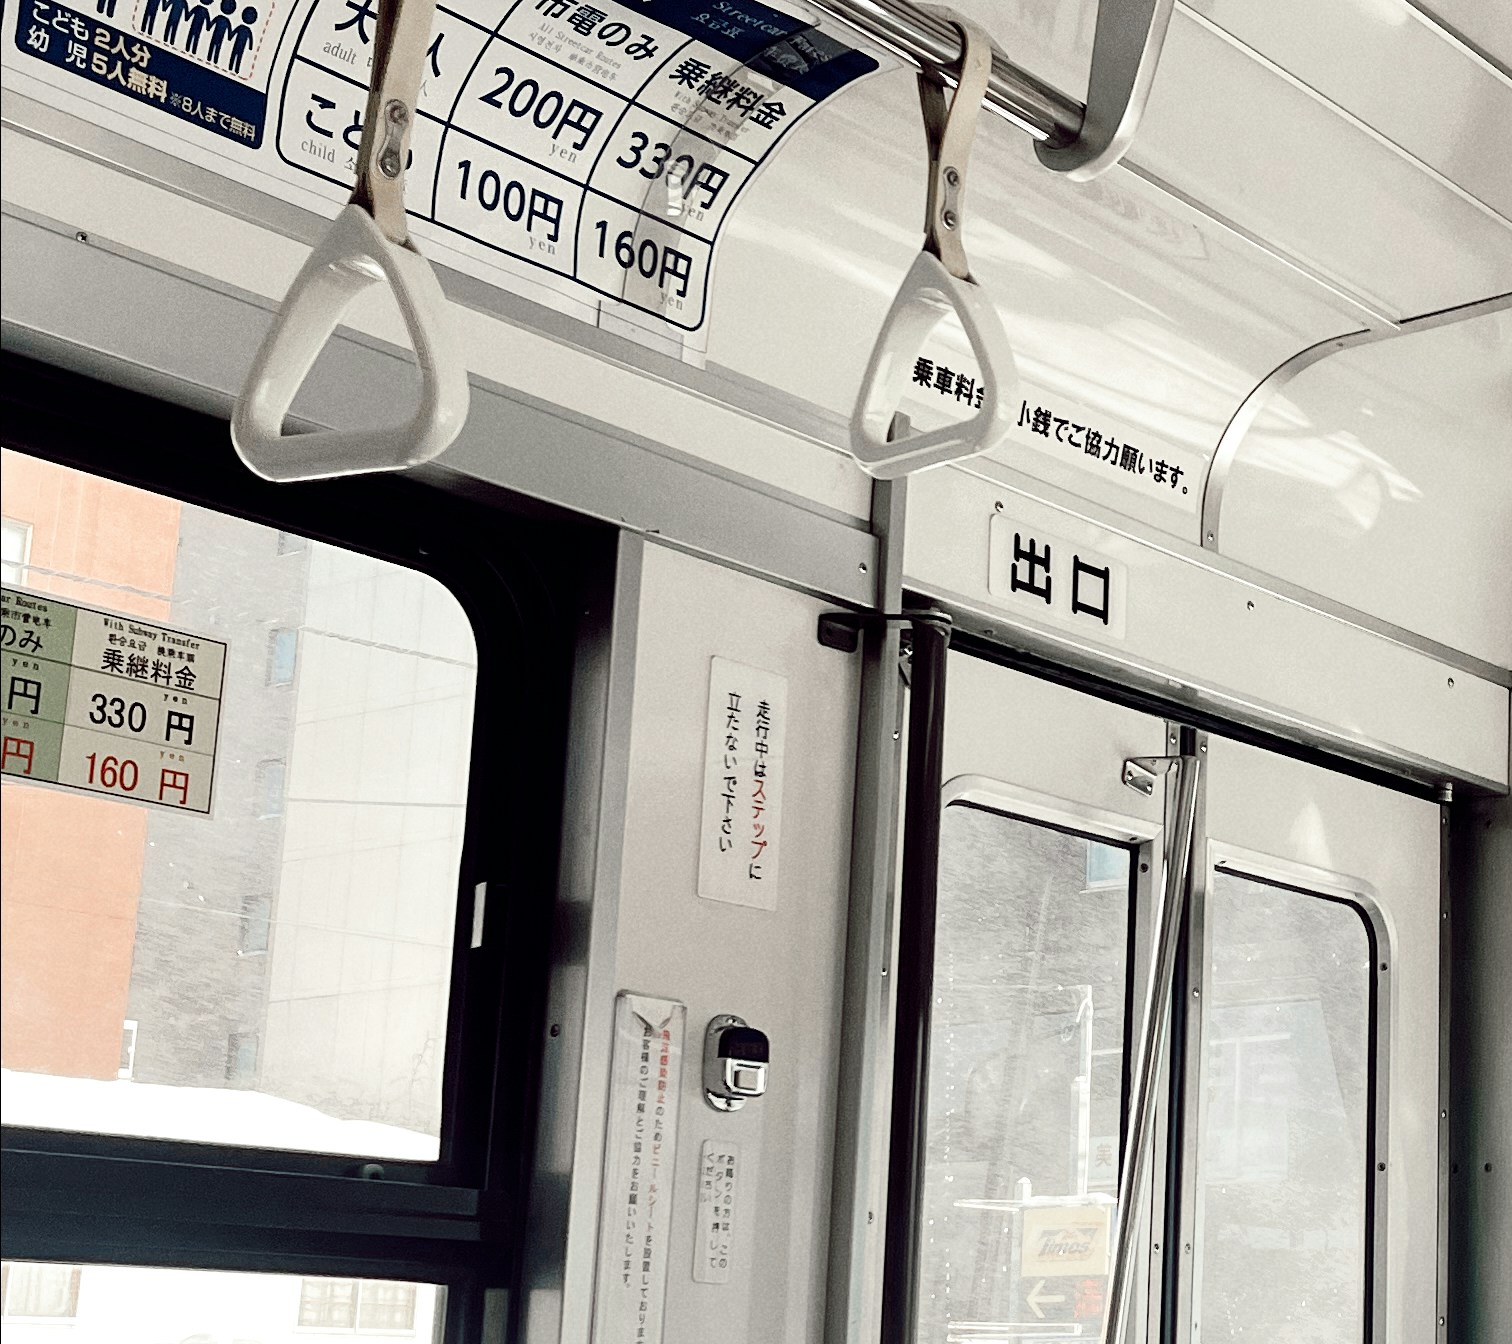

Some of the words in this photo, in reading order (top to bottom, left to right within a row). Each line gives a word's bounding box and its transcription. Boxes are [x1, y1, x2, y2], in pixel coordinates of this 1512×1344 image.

[32, 0, 153, 69] こども2人分
[323, 40, 357, 66] adult
[479, 66, 603, 151] 200円
[668, 57, 788, 131] 乗継料金
[301, 139, 336, 163] child
[548, 141, 578, 164] yen
[456, 159, 564, 243] 100円
[529, 235, 557, 256] yen
[594, 219, 693, 299] 160円
[1010, 531, 1111, 626] 出口
[8, 676, 42, 715] 円
[101, 648, 197, 691] 乗継料金
[89, 693, 147, 733] 330
[165, 710, 195, 746] 円
[2, 736, 35, 775] 円
[85, 752, 139, 792] 160
[158, 768, 190, 805] 円
[718, 691, 743, 853] 立たないで下さい
[748, 699, 772, 880] 走行中はステップに
